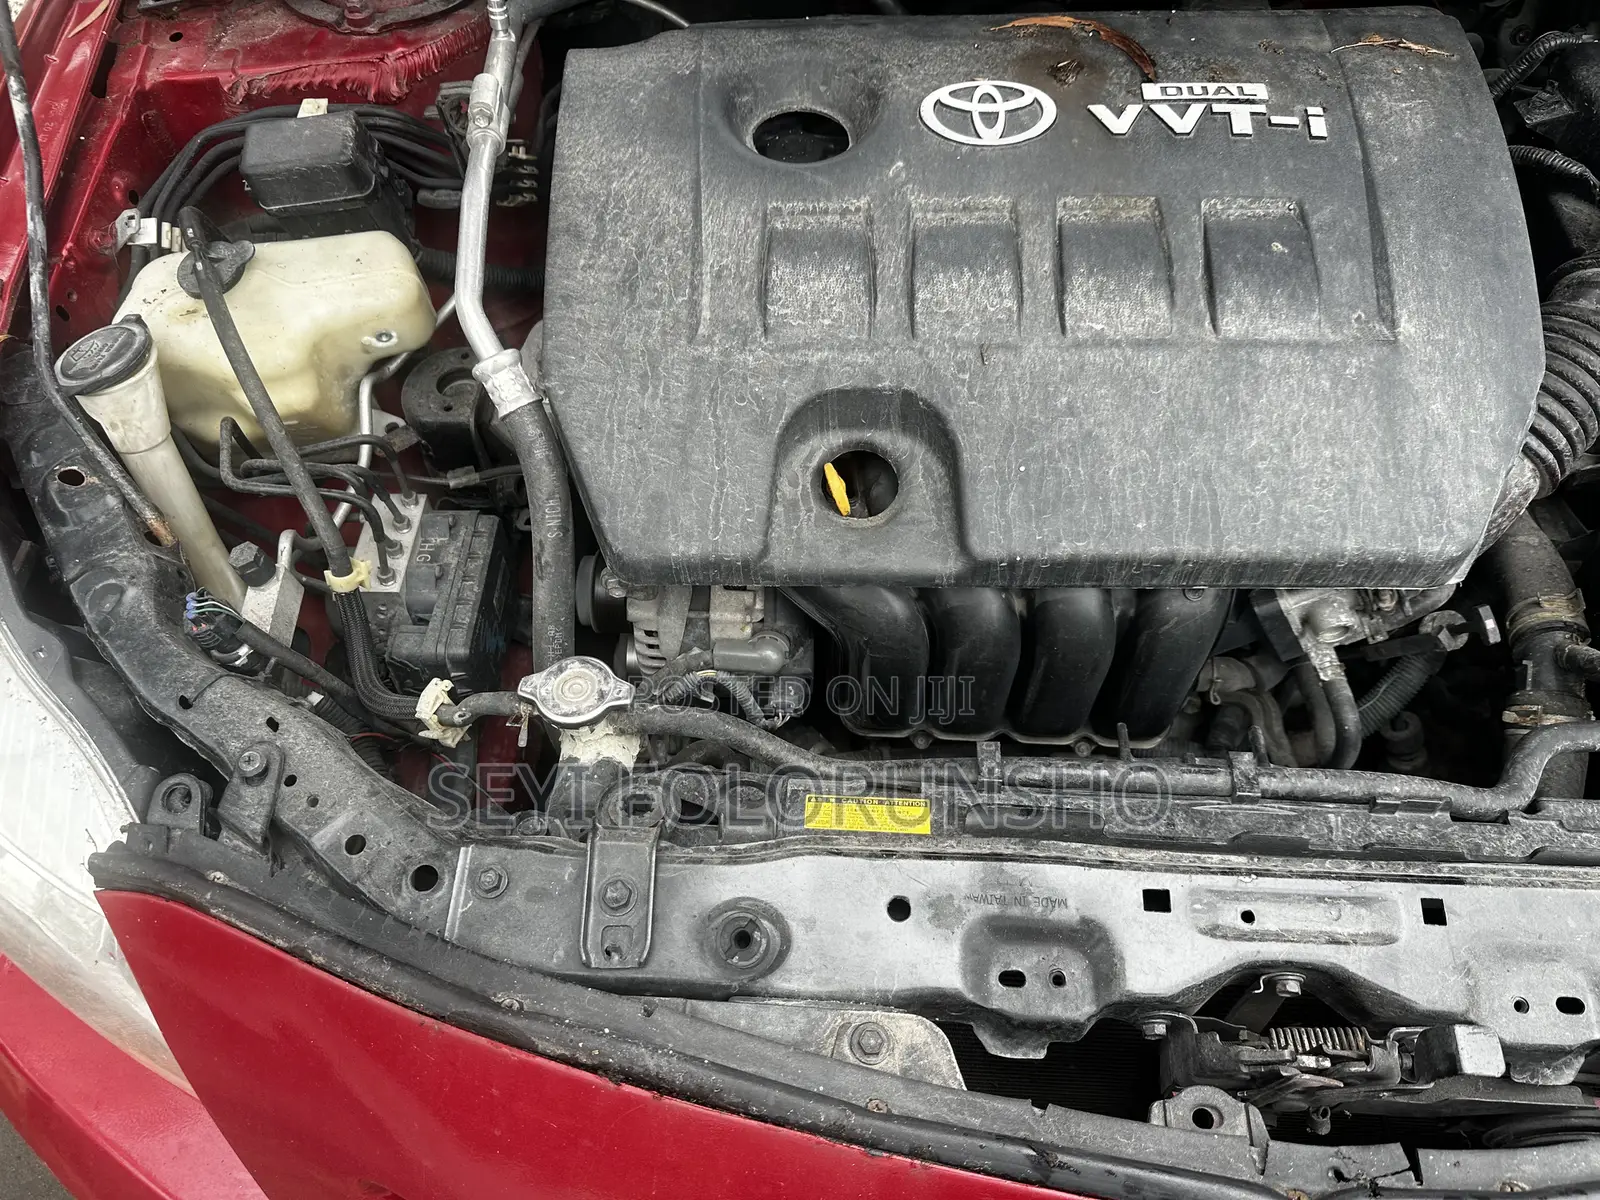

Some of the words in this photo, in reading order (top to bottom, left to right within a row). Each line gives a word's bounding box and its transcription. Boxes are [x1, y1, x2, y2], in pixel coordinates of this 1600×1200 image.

[1159, 85, 1257, 98] DUAL
[1087, 104, 1328, 140] VVT-i
[841, 798, 879, 806] CAUTION
[1013, 896, 1027, 907] IN
[1033, 896, 1068, 909] MADE
